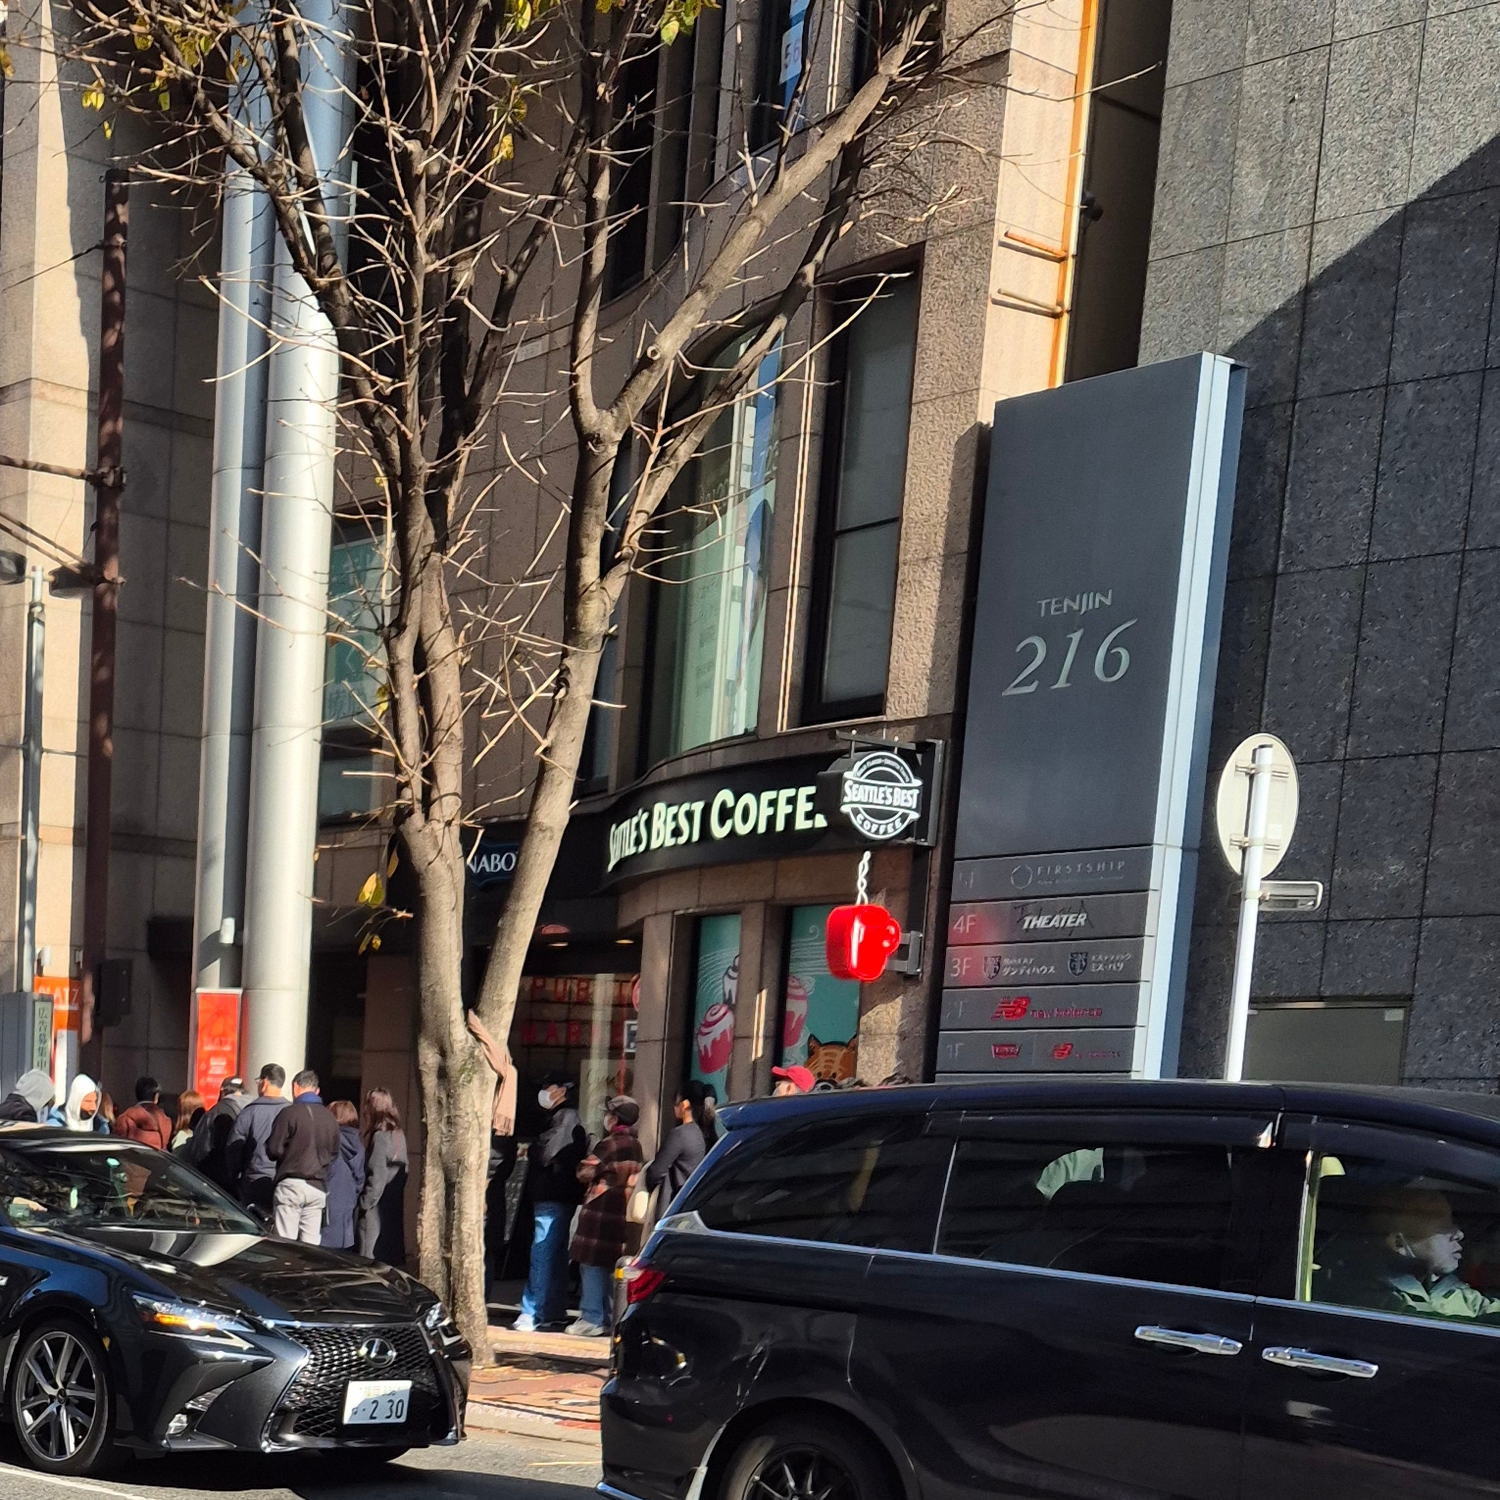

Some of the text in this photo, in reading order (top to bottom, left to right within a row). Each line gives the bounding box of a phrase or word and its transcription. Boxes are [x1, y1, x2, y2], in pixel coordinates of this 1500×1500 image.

[1037, 588, 1113, 618] TENJIN
[1001, 617, 1139, 697] 216
[843, 780, 920, 809] SEATTLE'S BEST
[650, 801, 705, 850] BEST
[856, 813, 903, 835] COFFEE
[467, 852, 518, 873] NABO
[953, 914, 977, 934] 4F
[1022, 913, 1088, 930] THEATER
[950, 957, 972, 977] 3F
